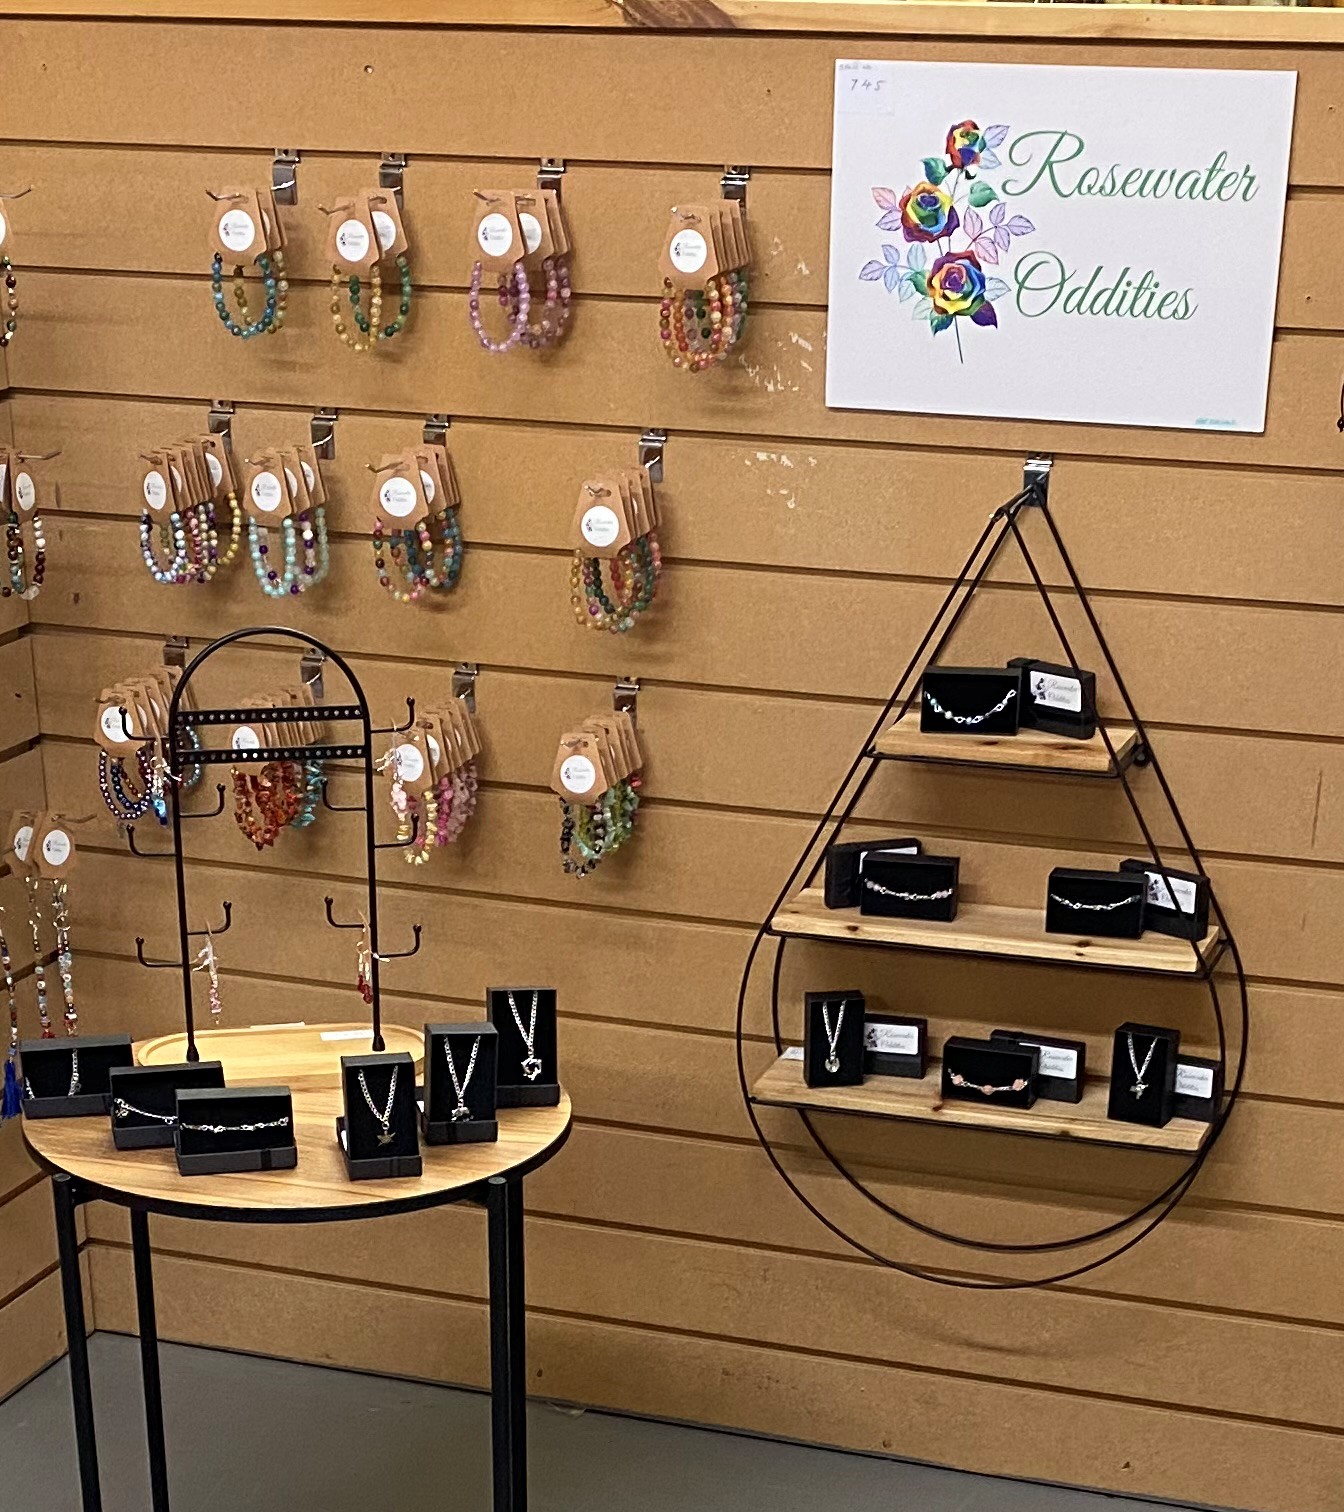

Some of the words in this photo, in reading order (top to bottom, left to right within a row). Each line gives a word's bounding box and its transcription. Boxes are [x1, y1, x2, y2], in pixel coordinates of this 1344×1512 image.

[851, 78, 886, 92] 745
[1001, 129, 1260, 202] Rosewater
[1014, 250, 1199, 321] Oddities
